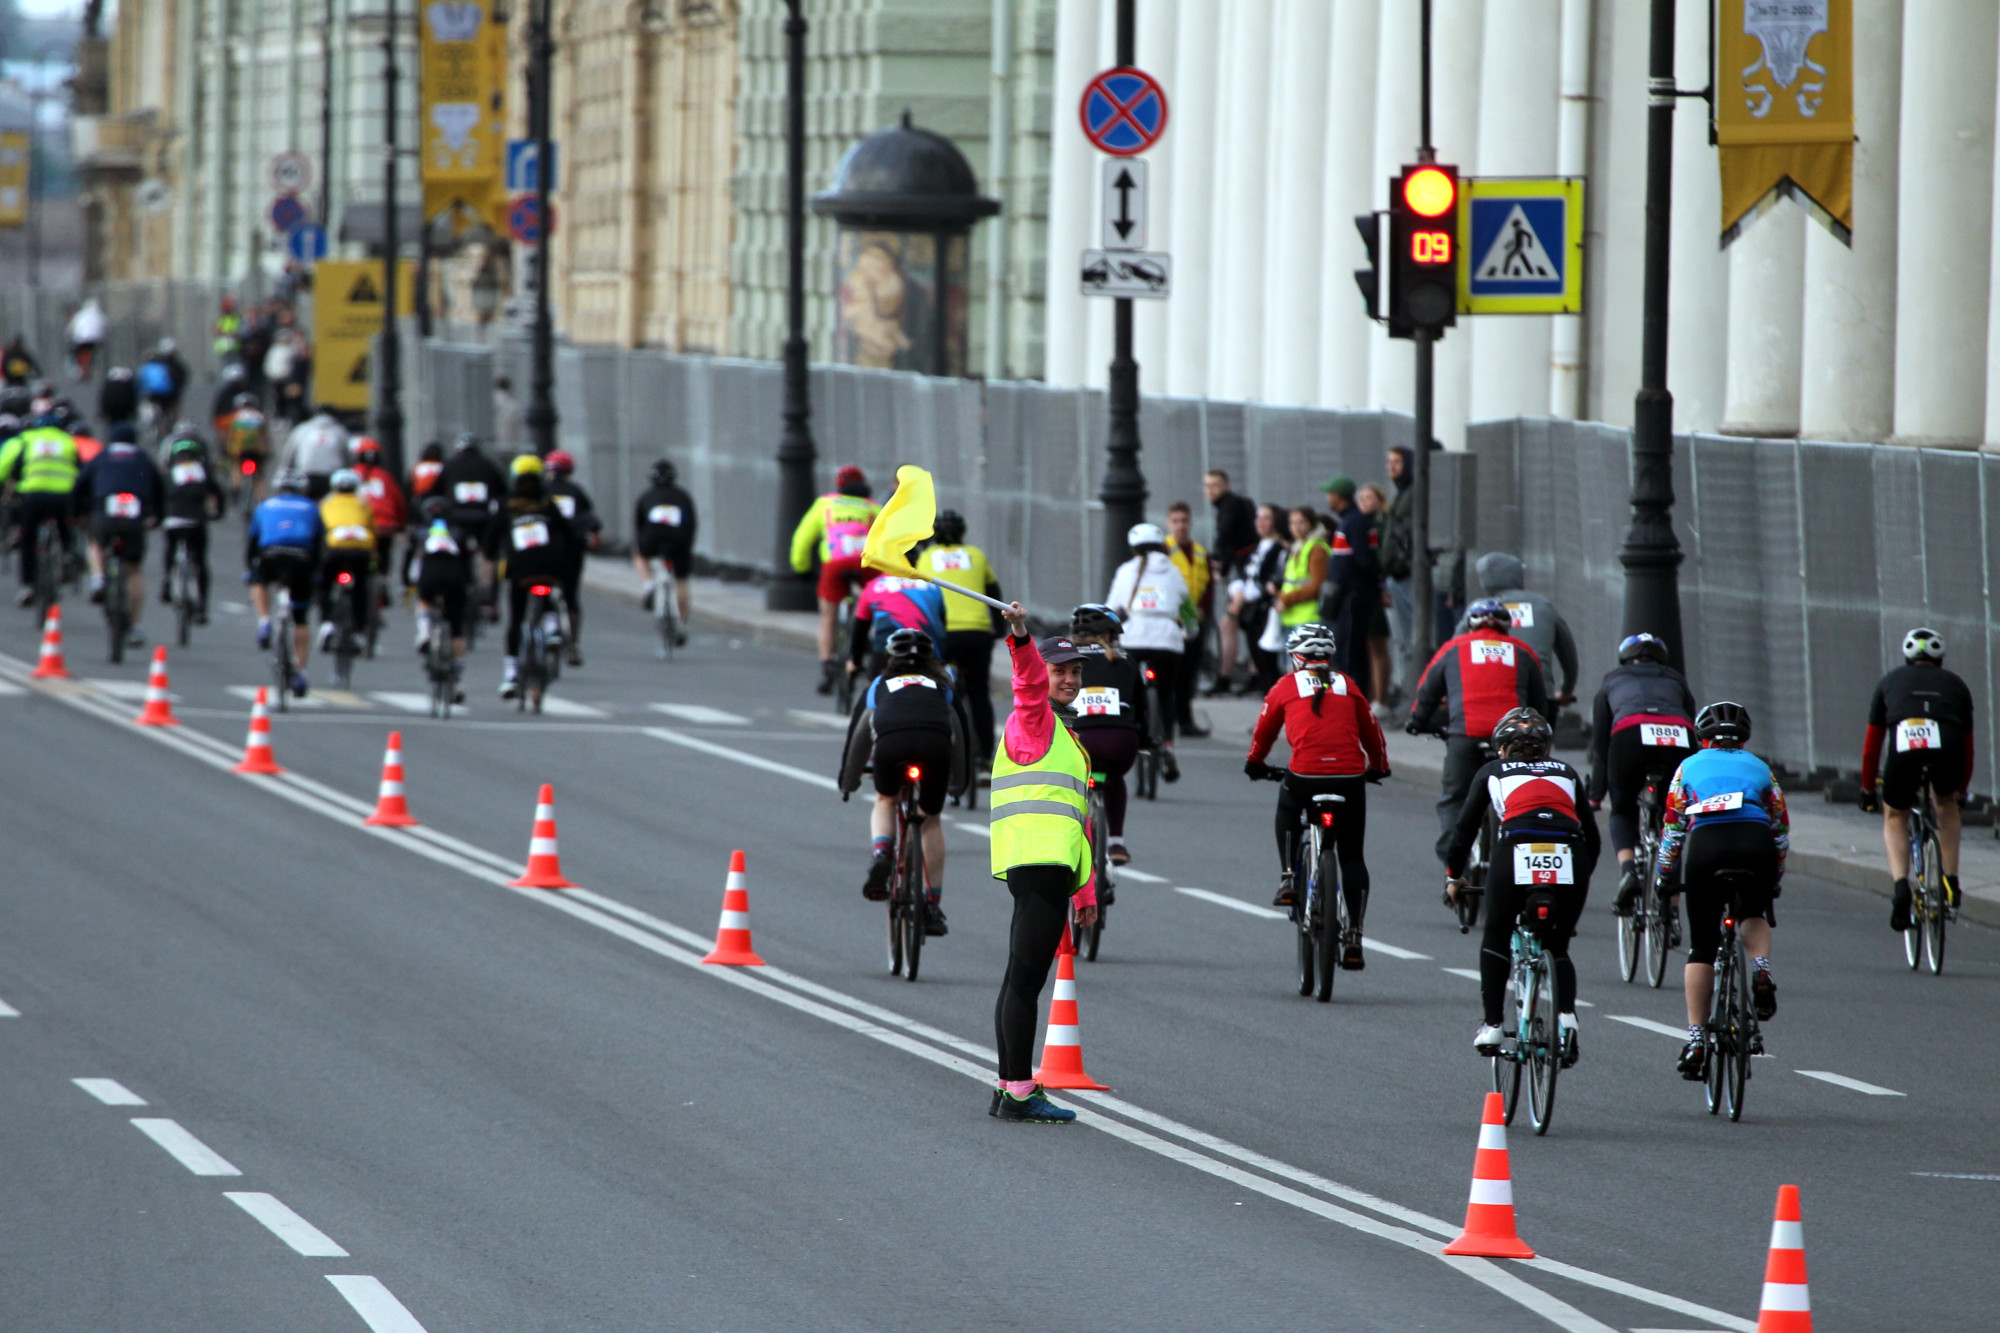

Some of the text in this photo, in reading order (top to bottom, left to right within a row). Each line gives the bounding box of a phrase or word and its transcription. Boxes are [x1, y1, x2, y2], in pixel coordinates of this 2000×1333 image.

[1412, 232, 1451, 262] 09
[1480, 647, 1506, 656] 1552
[1081, 695, 1111, 705] 1884
[1650, 727, 1680, 737] 1888
[1904, 727, 1931, 738] 1401
[1699, 794, 1733, 805] 220
[1524, 856, 1563, 869] 1450
[1538, 871, 1552, 879] 40
